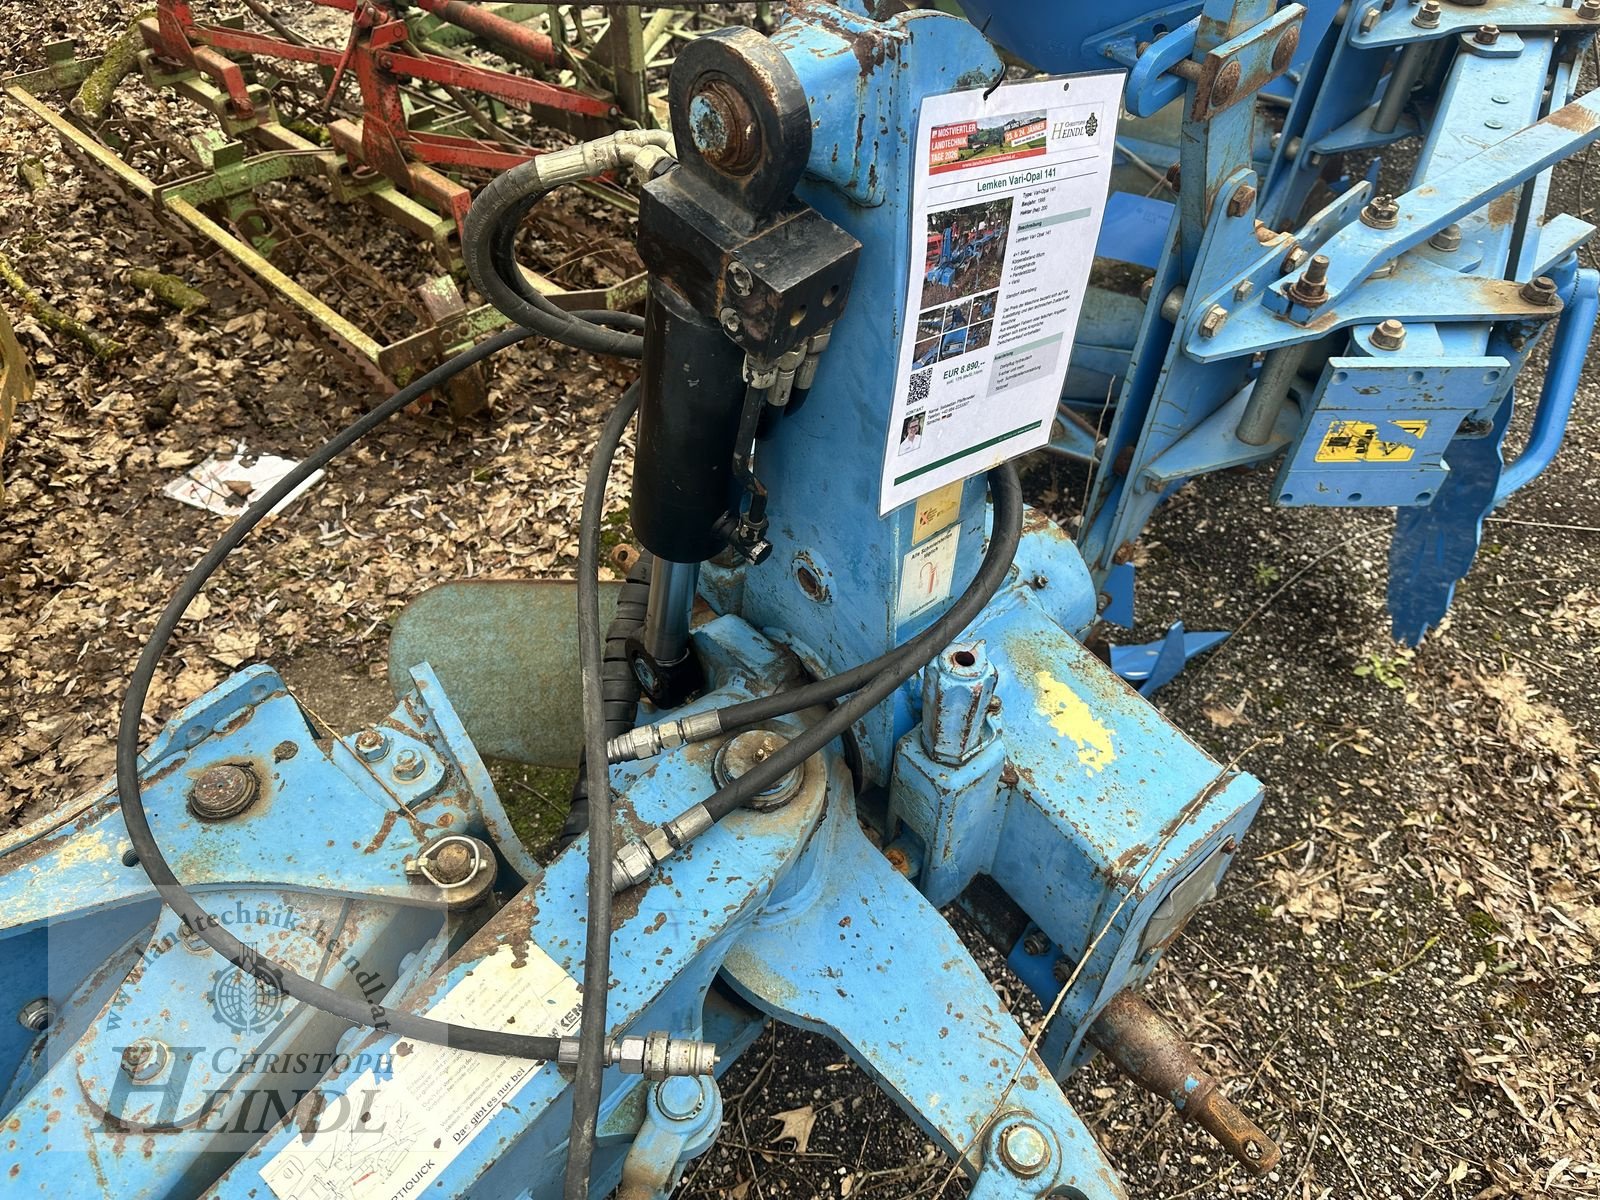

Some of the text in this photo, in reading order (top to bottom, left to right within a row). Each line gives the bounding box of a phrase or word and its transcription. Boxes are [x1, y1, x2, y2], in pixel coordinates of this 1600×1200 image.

[938, 124, 976, 138] MOSTVIERTLER
[1051, 122, 1084, 140] HEINDL
[932, 137, 967, 151] LANDTECHNIK
[931, 151, 945, 162] TAGE
[977, 168, 1056, 192] Lemken Vari-Opal 141
[944, 367, 959, 379] EUR
[906, 406, 924, 416] KONTAKT
[453, 1124, 470, 1142] Das
[470, 1107, 487, 1128] gibt
[486, 1096, 498, 1108] es
[497, 1082, 511, 1097] nur
[510, 1067, 525, 1082] bei
